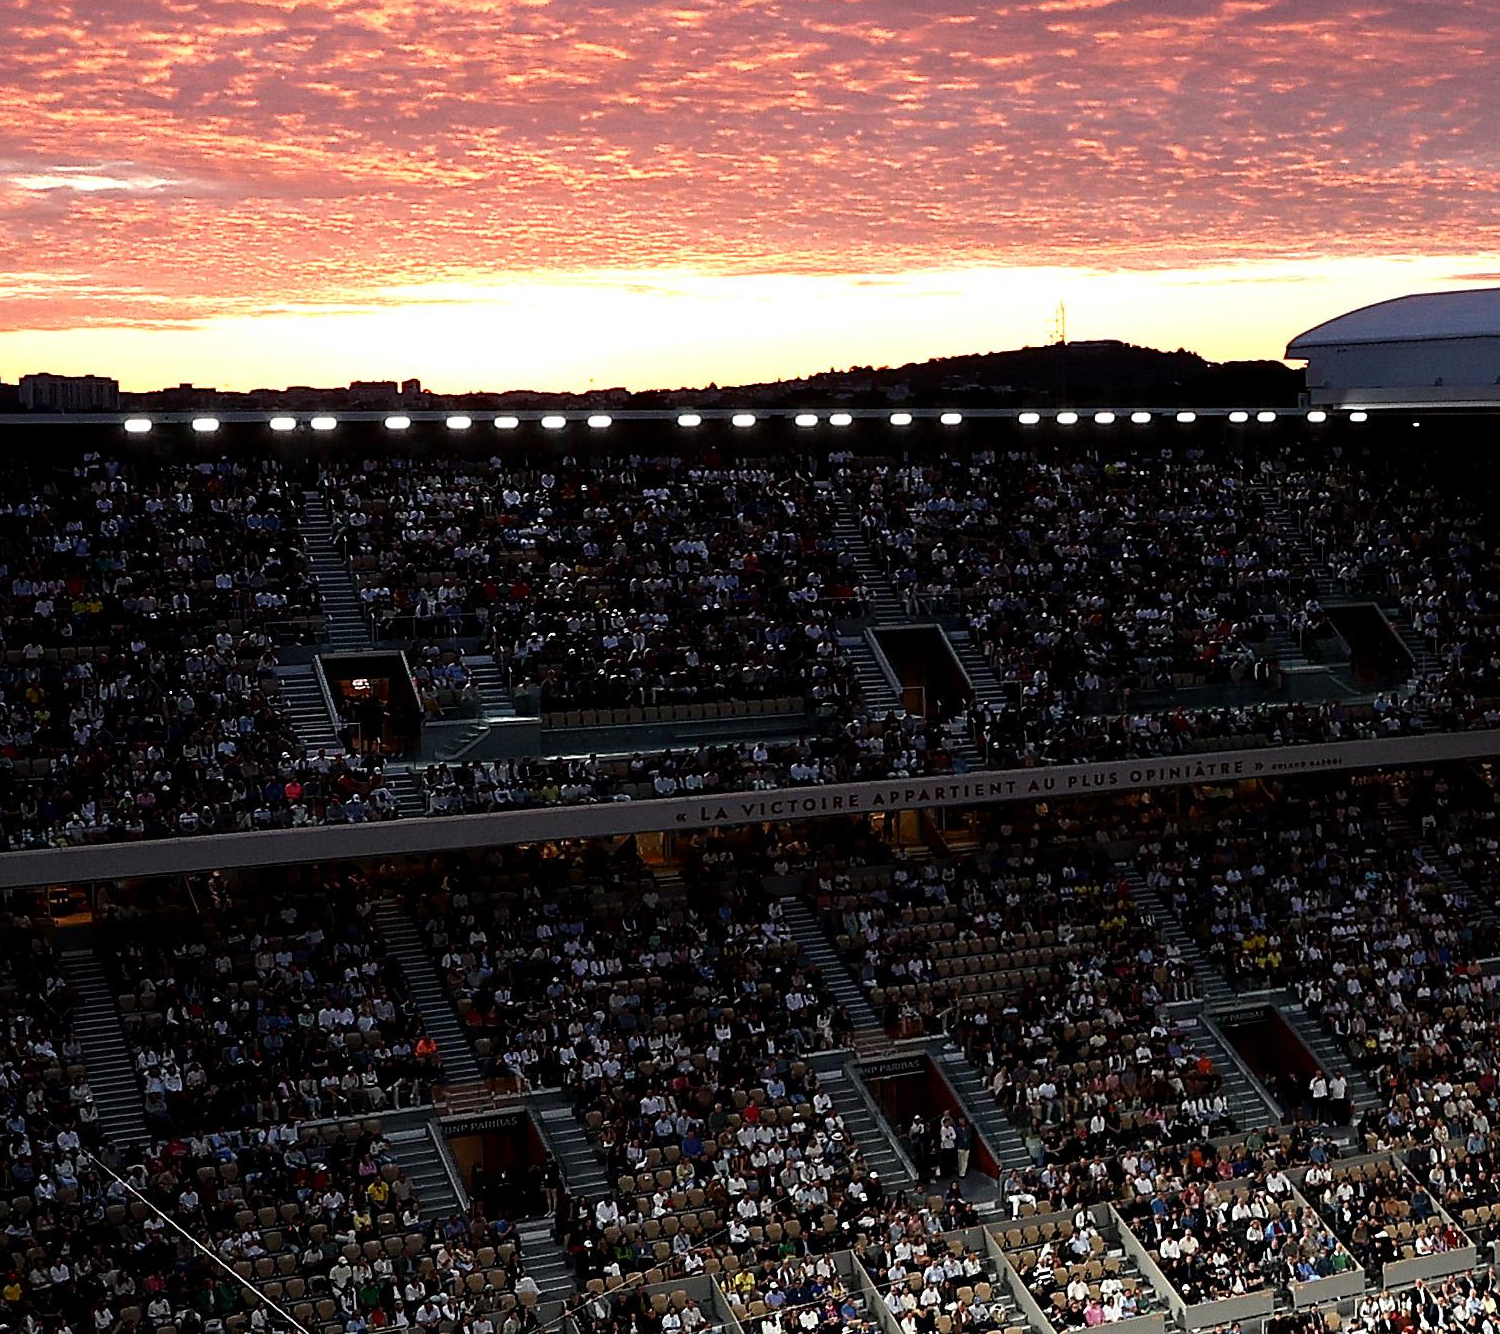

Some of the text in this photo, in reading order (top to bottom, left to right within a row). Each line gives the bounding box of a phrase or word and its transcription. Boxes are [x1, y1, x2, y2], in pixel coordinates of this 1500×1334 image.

[701, 807, 728, 821] LA
[741, 794, 859, 817] VICTOIRE
[873, 781, 1016, 805] APPARTIENT
[1028, 778, 1055, 792] AU
[1068, 773, 1118, 788] PLUS
[1130, 761, 1243, 783] OPINIÂTRE
